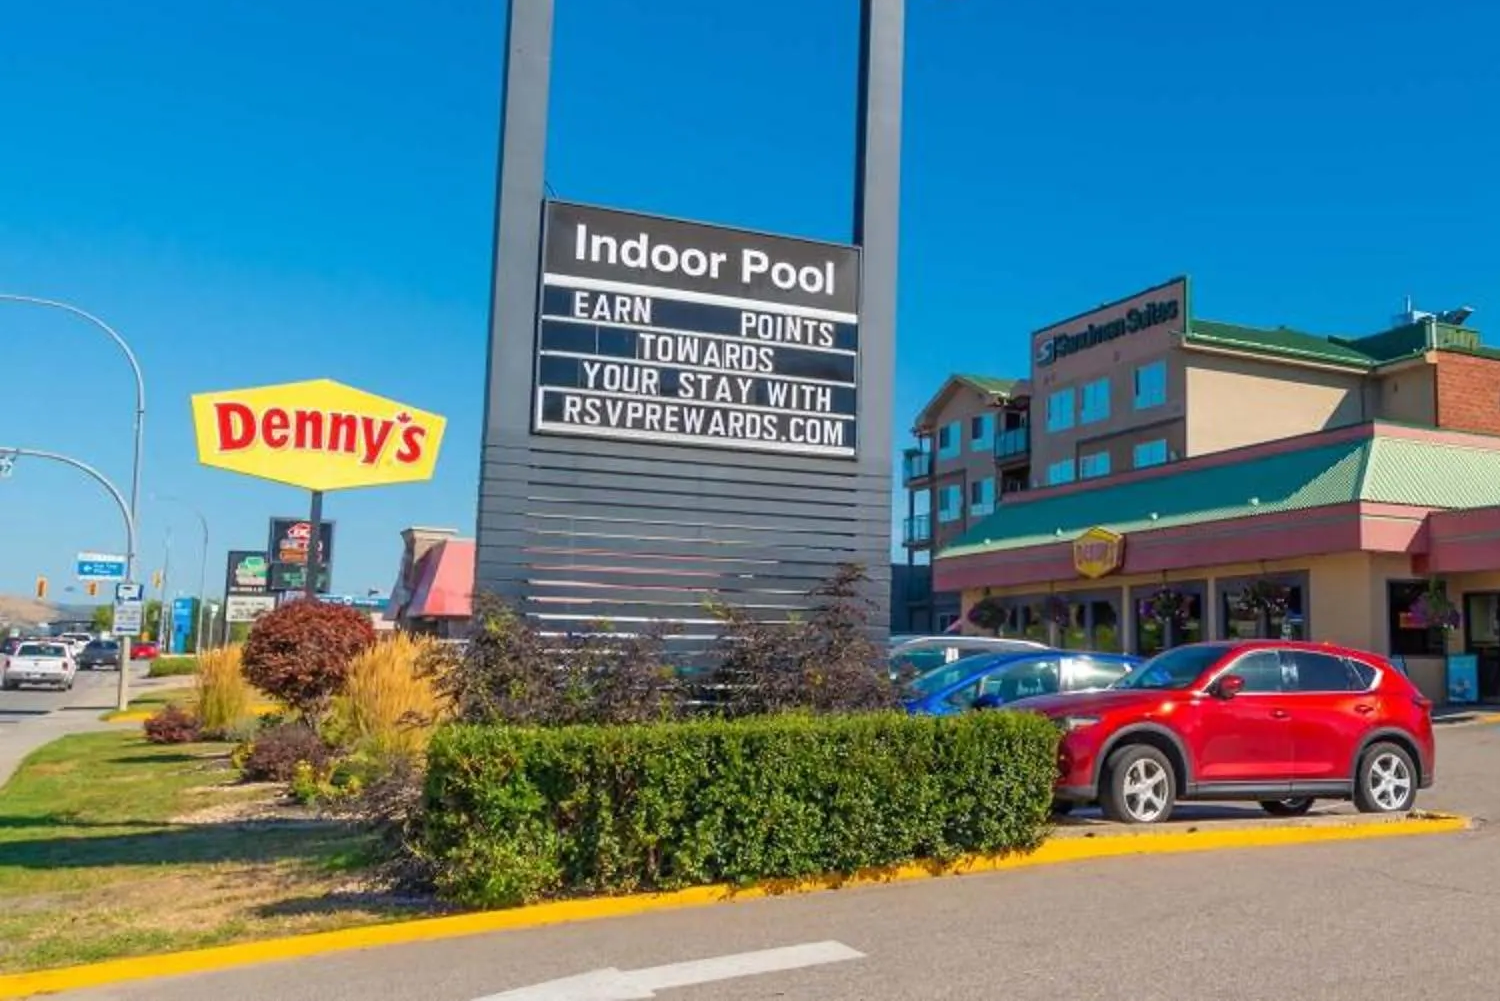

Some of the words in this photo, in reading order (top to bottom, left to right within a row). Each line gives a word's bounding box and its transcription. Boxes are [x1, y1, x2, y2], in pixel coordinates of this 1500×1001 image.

[574, 223, 727, 279] Indoor
[741, 248, 836, 296] Pool
[573, 290, 651, 325] EARN
[740, 311, 834, 348] POINTS
[639, 332, 775, 373] TOWARDS
[583, 361, 659, 397] YOUR
[678, 372, 753, 406] STAY
[767, 381, 832, 412] WITH
[214, 402, 425, 464] Denny's
[563, 396, 844, 446] RSVPREWARDS.COM
